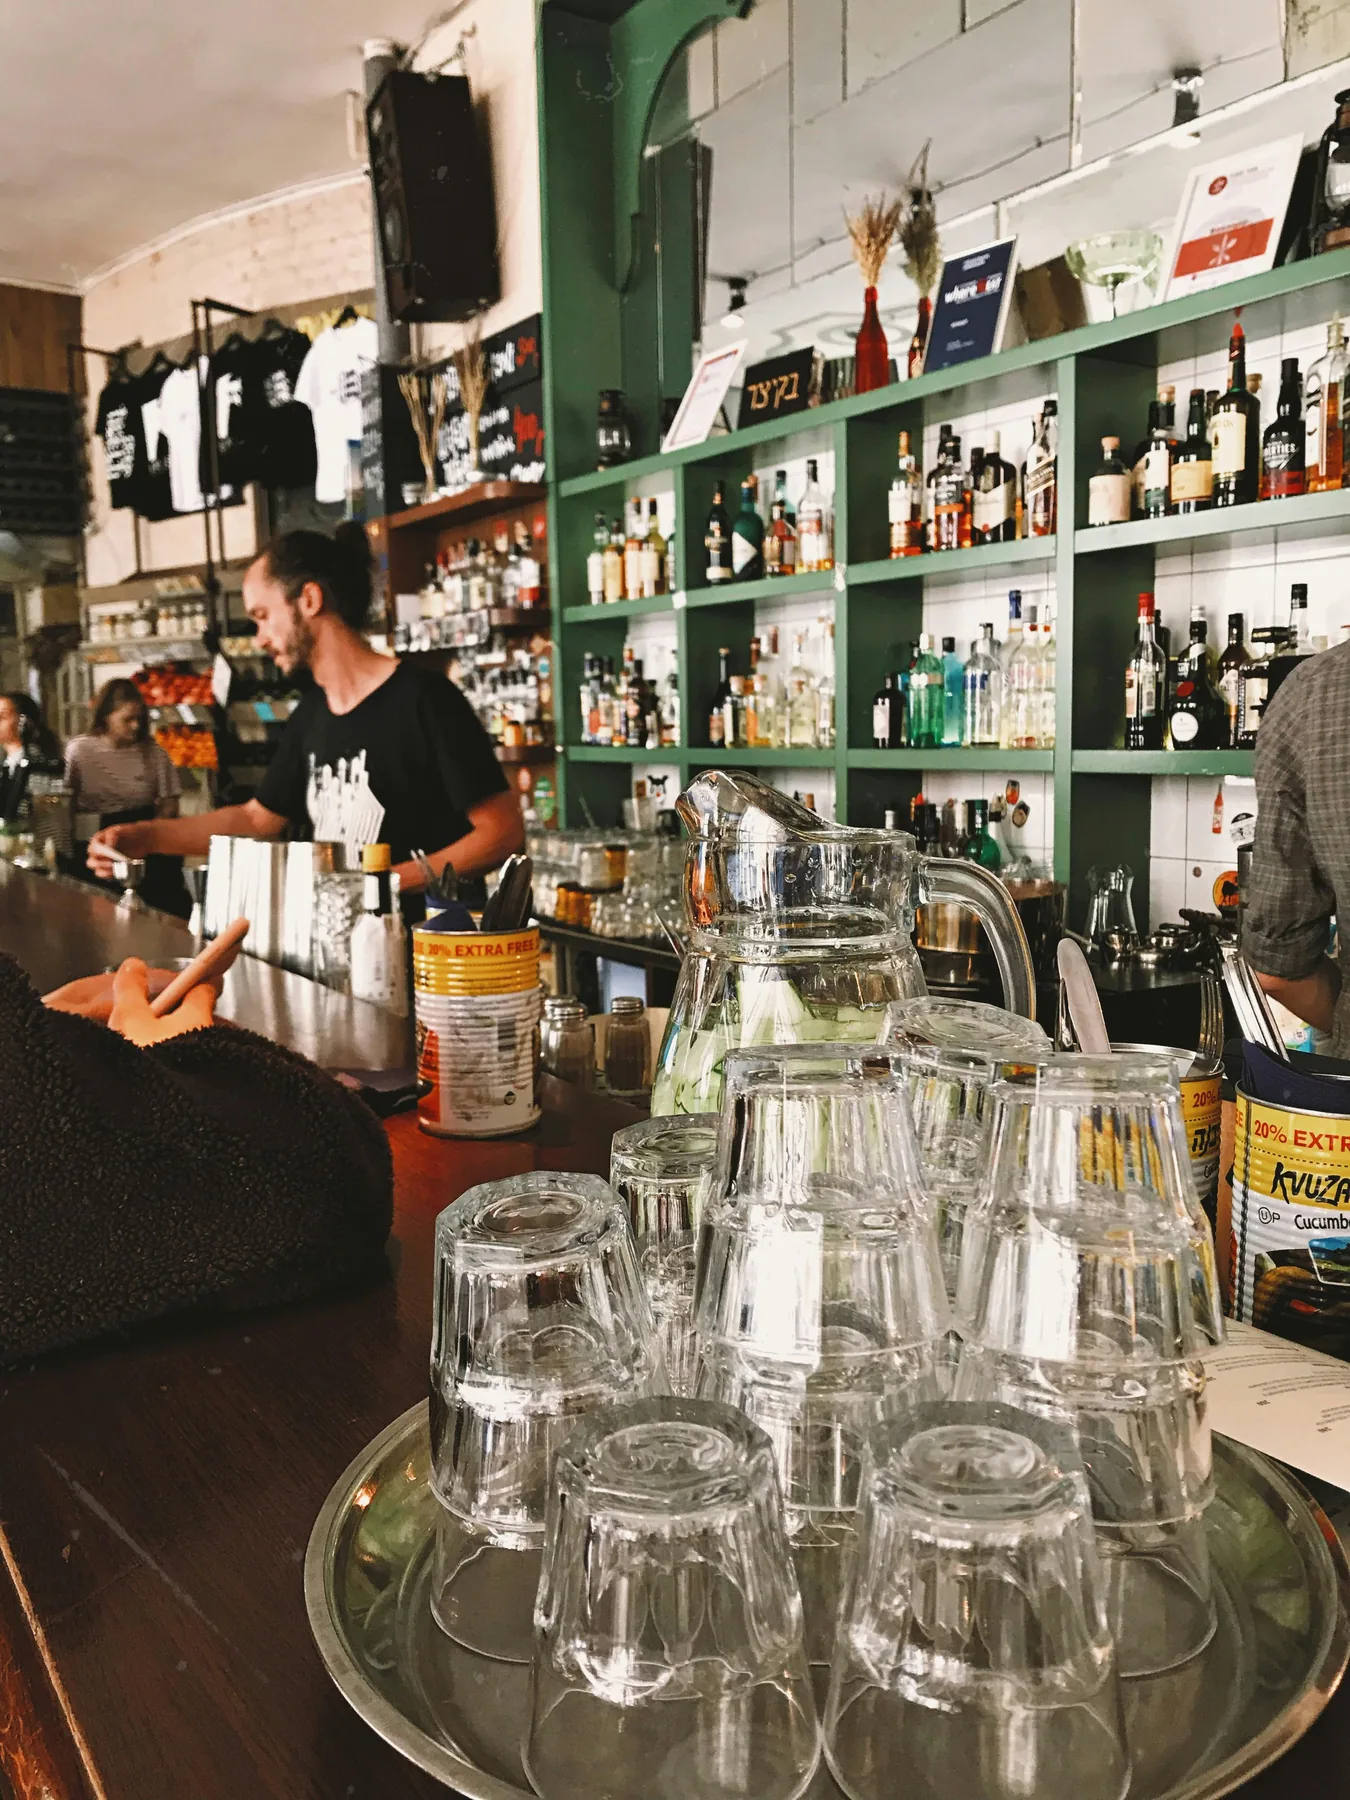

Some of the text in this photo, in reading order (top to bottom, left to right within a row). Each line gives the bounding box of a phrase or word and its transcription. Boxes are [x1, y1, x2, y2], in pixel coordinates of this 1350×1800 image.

[455, 944, 504, 957] EXTRA
[507, 939, 534, 955] FREE
[1192, 1090, 1217, 1108] 20%
[1254, 1119, 1288, 1144] 20%
[1293, 1129, 1350, 1152] EXTR
[1270, 1161, 1350, 1207] KVUZA
[1294, 1213, 1350, 1230] Cucumb
